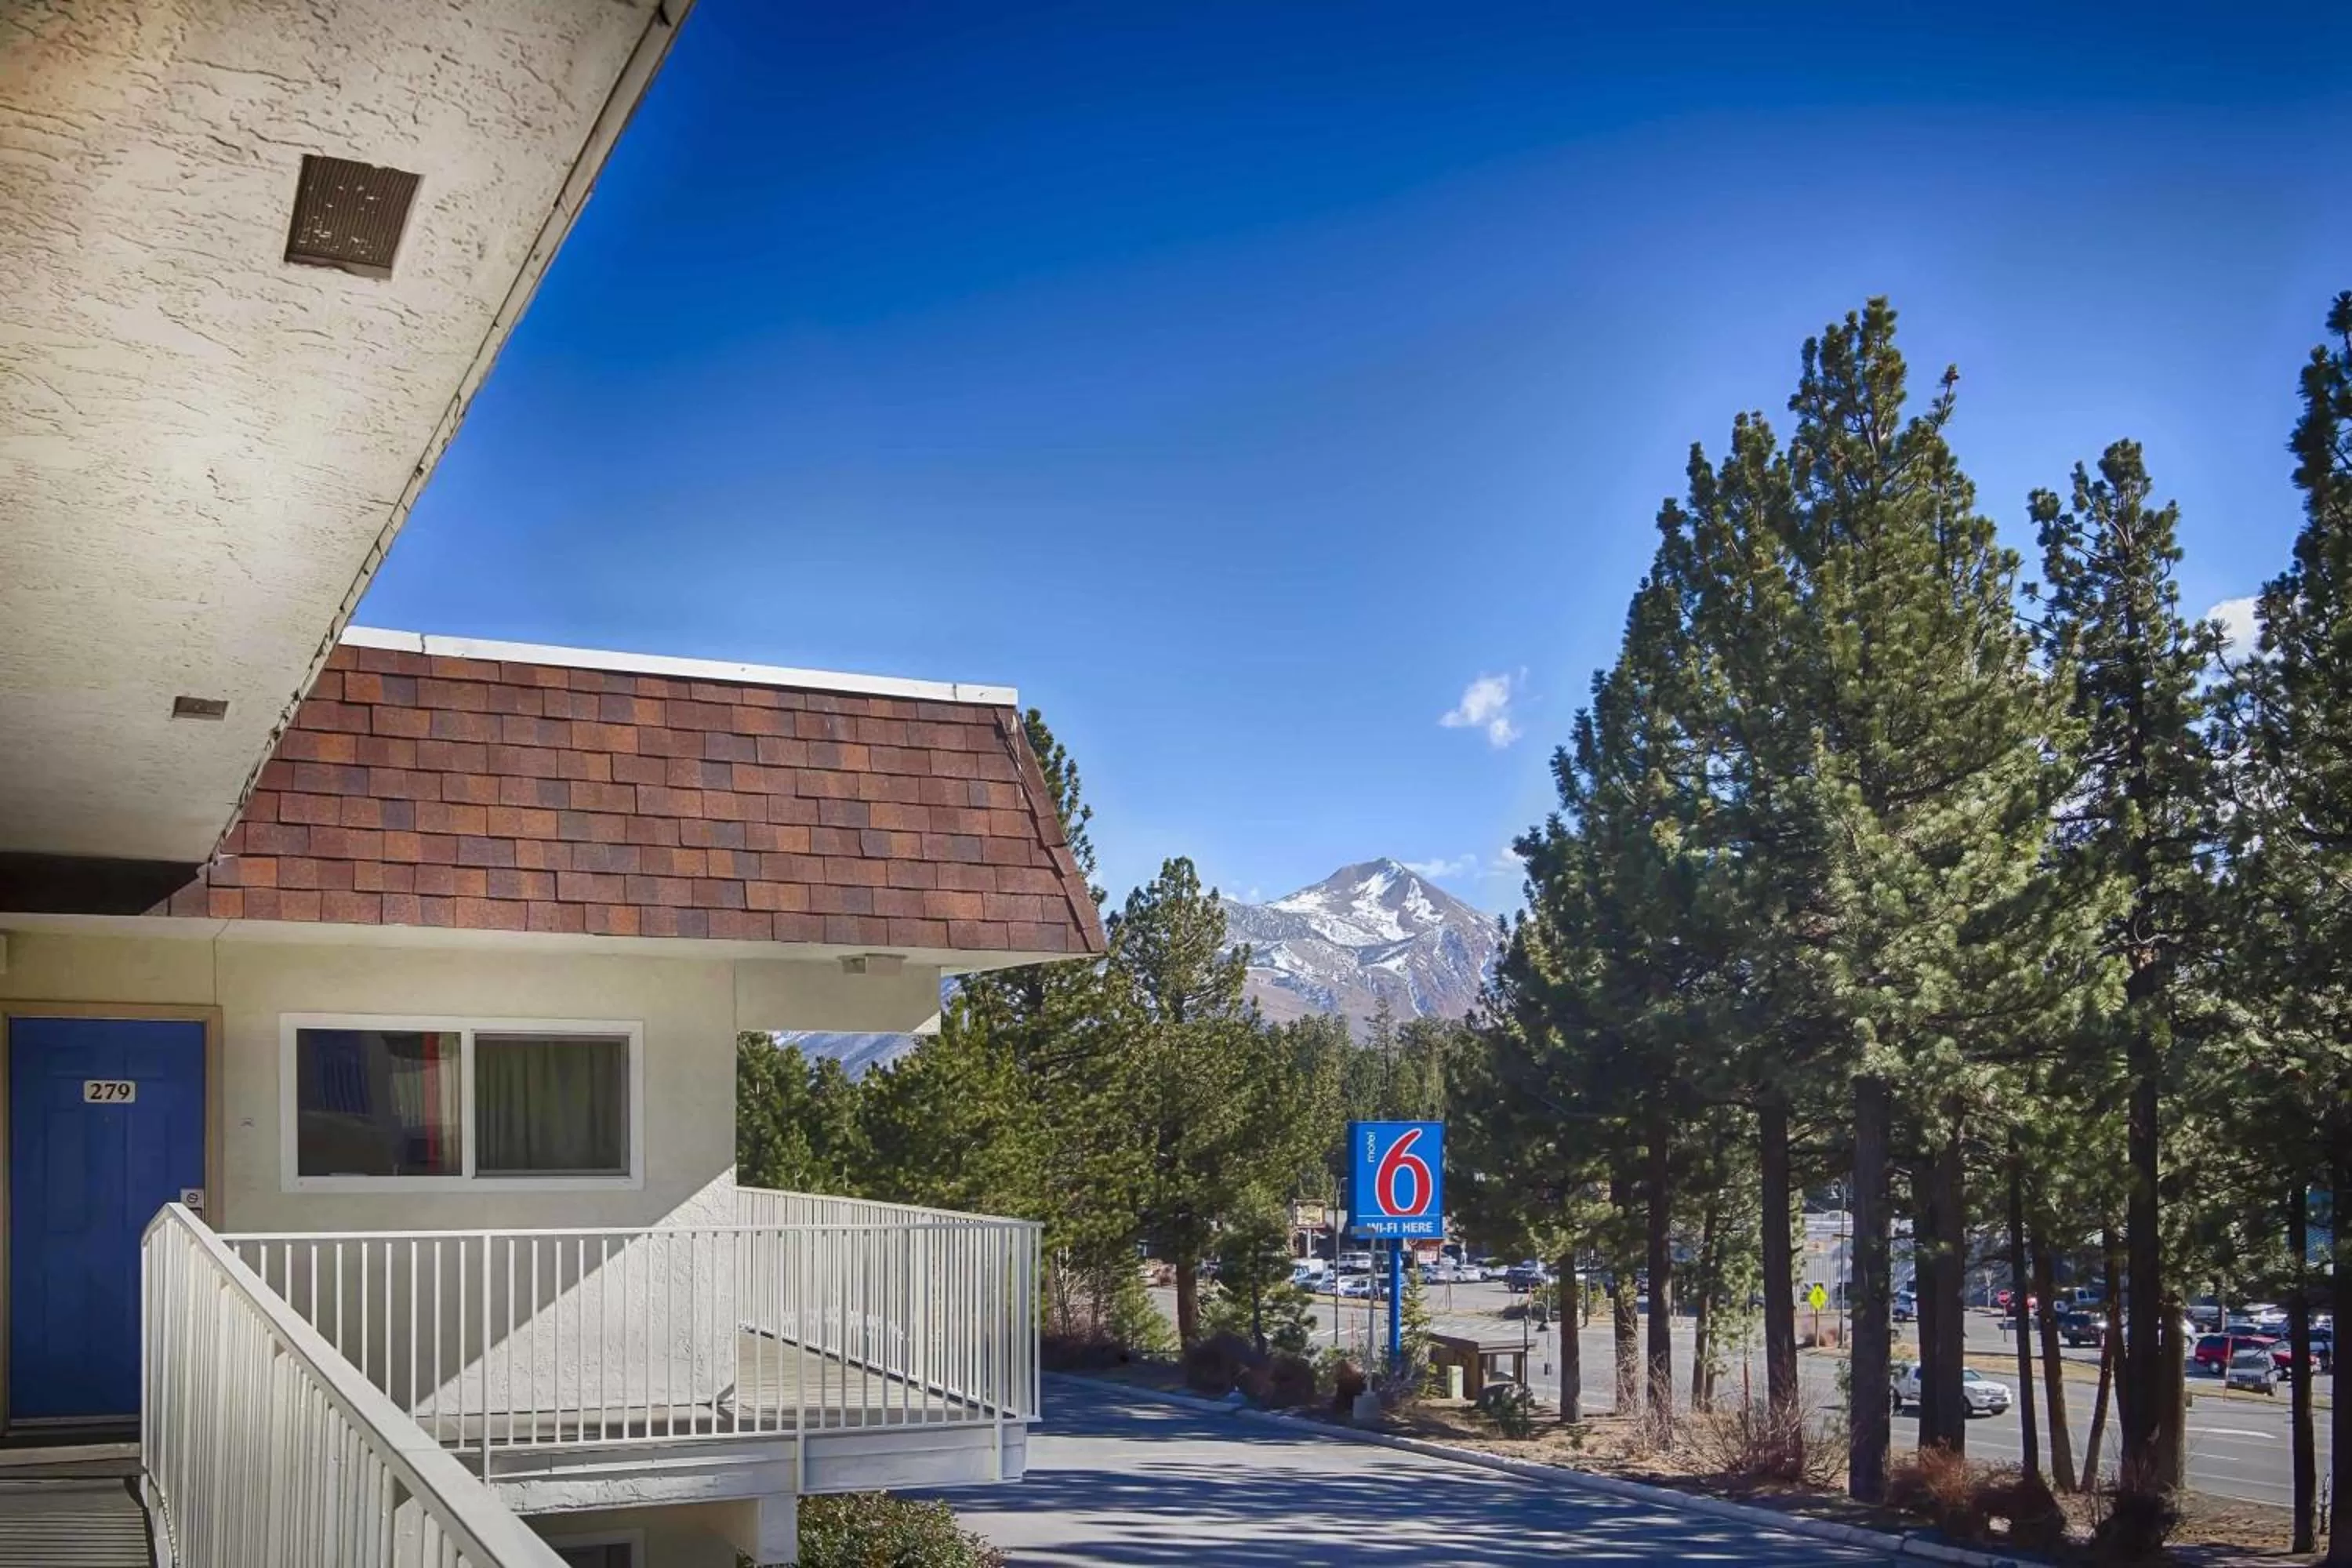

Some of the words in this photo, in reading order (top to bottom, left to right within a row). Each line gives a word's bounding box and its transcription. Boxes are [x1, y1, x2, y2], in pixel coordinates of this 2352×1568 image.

[90, 1083, 130, 1100] 279
[1366, 1132, 1376, 1163] motel
[1375, 1127, 1432, 1216] 6
[1402, 1221, 1434, 1233] HERE
